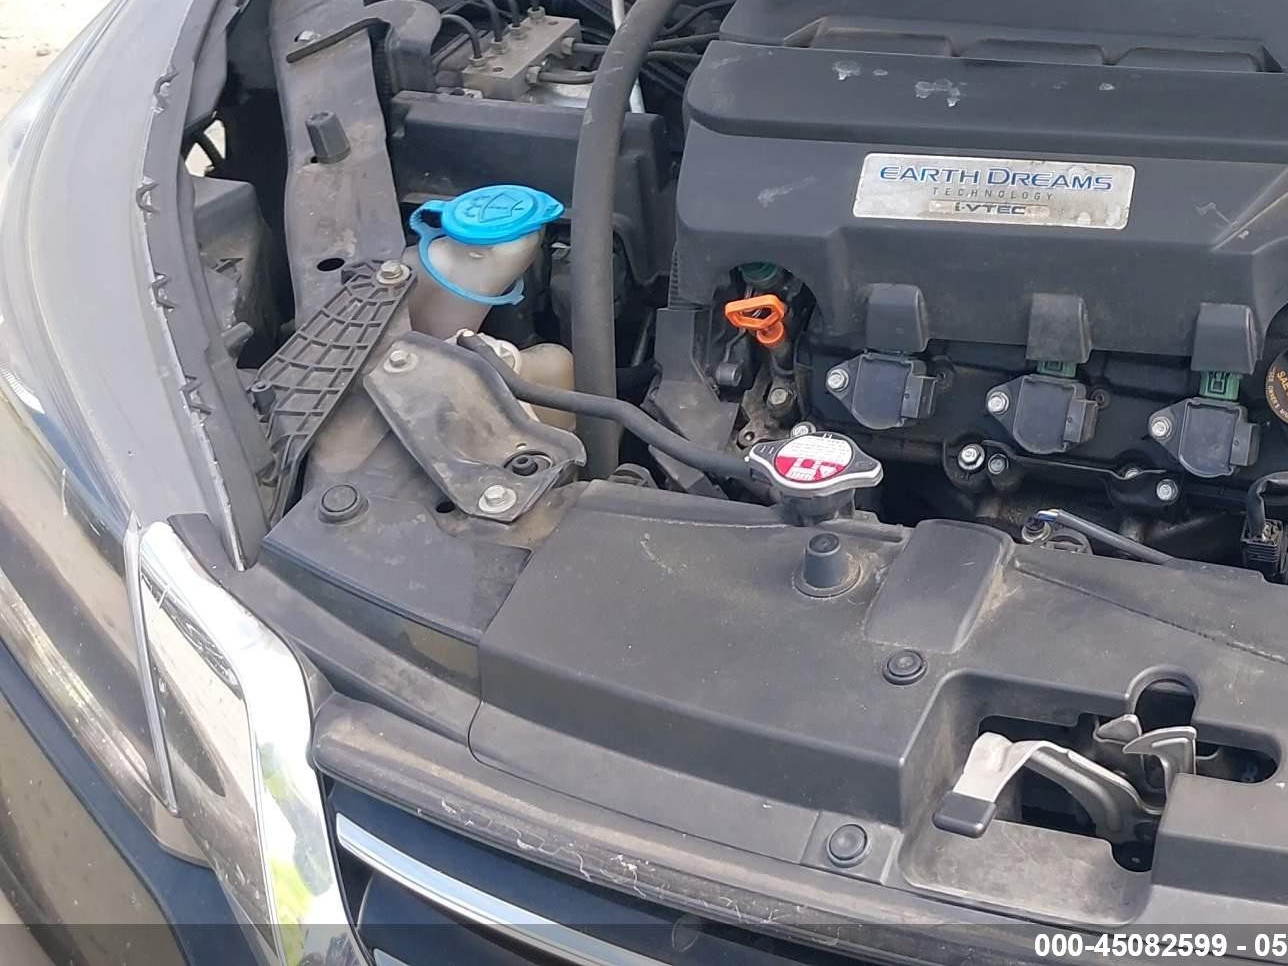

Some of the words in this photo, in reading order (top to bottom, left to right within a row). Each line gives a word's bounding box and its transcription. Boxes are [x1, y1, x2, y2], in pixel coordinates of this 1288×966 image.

[879, 165, 979, 185] EARTH
[987, 168, 1113, 190] DREAMS
[932, 186, 1054, 201] TECHNOLOGY
[954, 202, 1027, 215] i-VTEC
